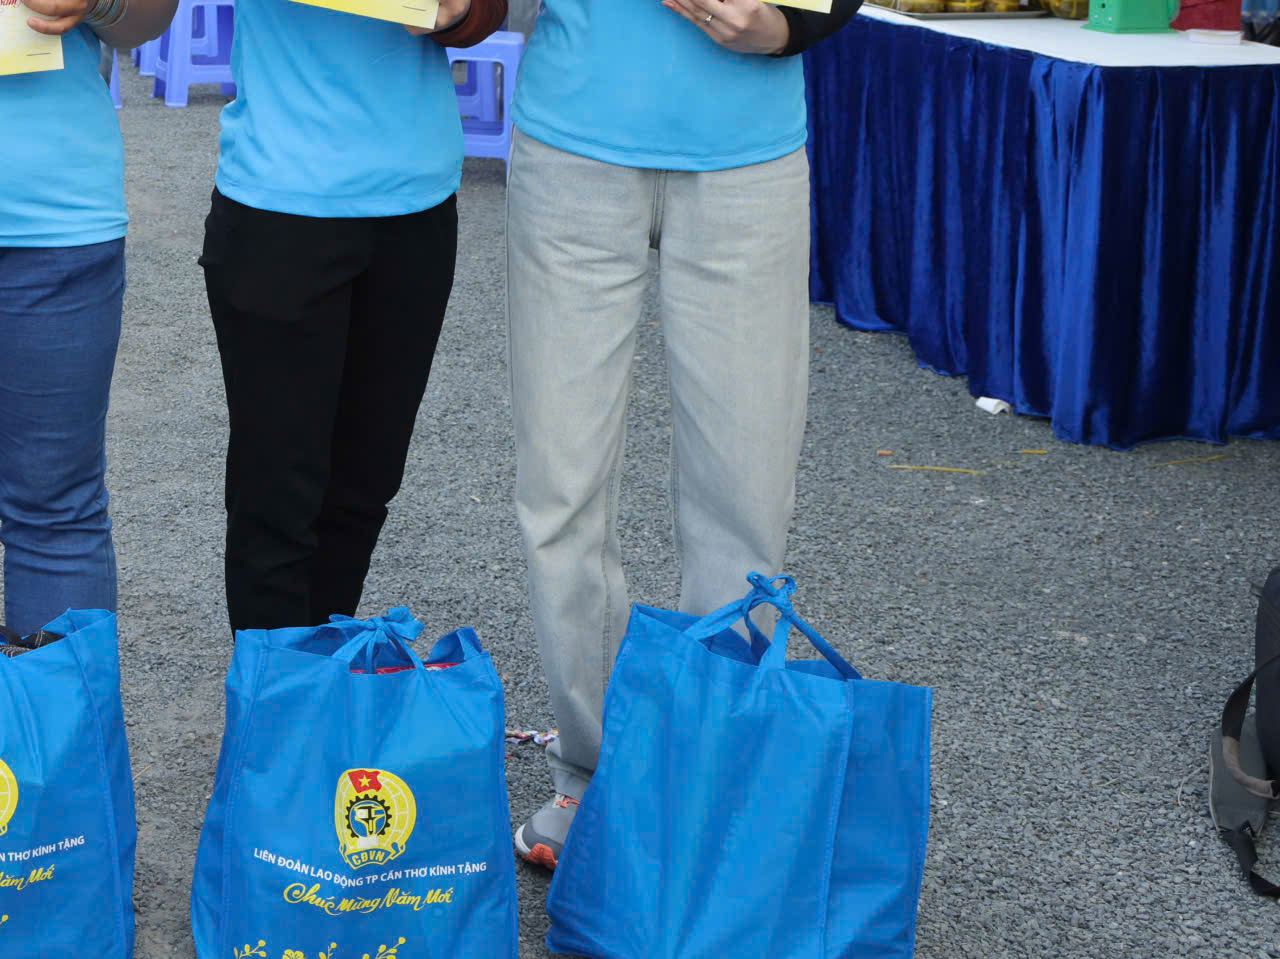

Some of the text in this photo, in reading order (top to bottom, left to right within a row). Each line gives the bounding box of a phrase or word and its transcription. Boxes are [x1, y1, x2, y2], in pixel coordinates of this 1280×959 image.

[7, 850, 30, 862] THƠ
[32, 844, 56, 857] KÍNH
[57, 835, 85, 851] TẶNG
[351, 850, 385, 865] CĐVN
[25, 864, 55, 884] Mới
[254, 847, 276, 864] LIÊN
[277, 856, 309, 874] ĐOÀN
[310, 866, 333, 881] LAO
[333, 874, 363, 888] ĐỘNG
[365, 874, 378, 884] TP
[404, 867, 427, 878] THƠ
[429, 864, 455, 877] KÍNH
[457, 861, 487, 876] TẶNG
[283, 883, 454, 916] Chúc Mừng Năm Mới
